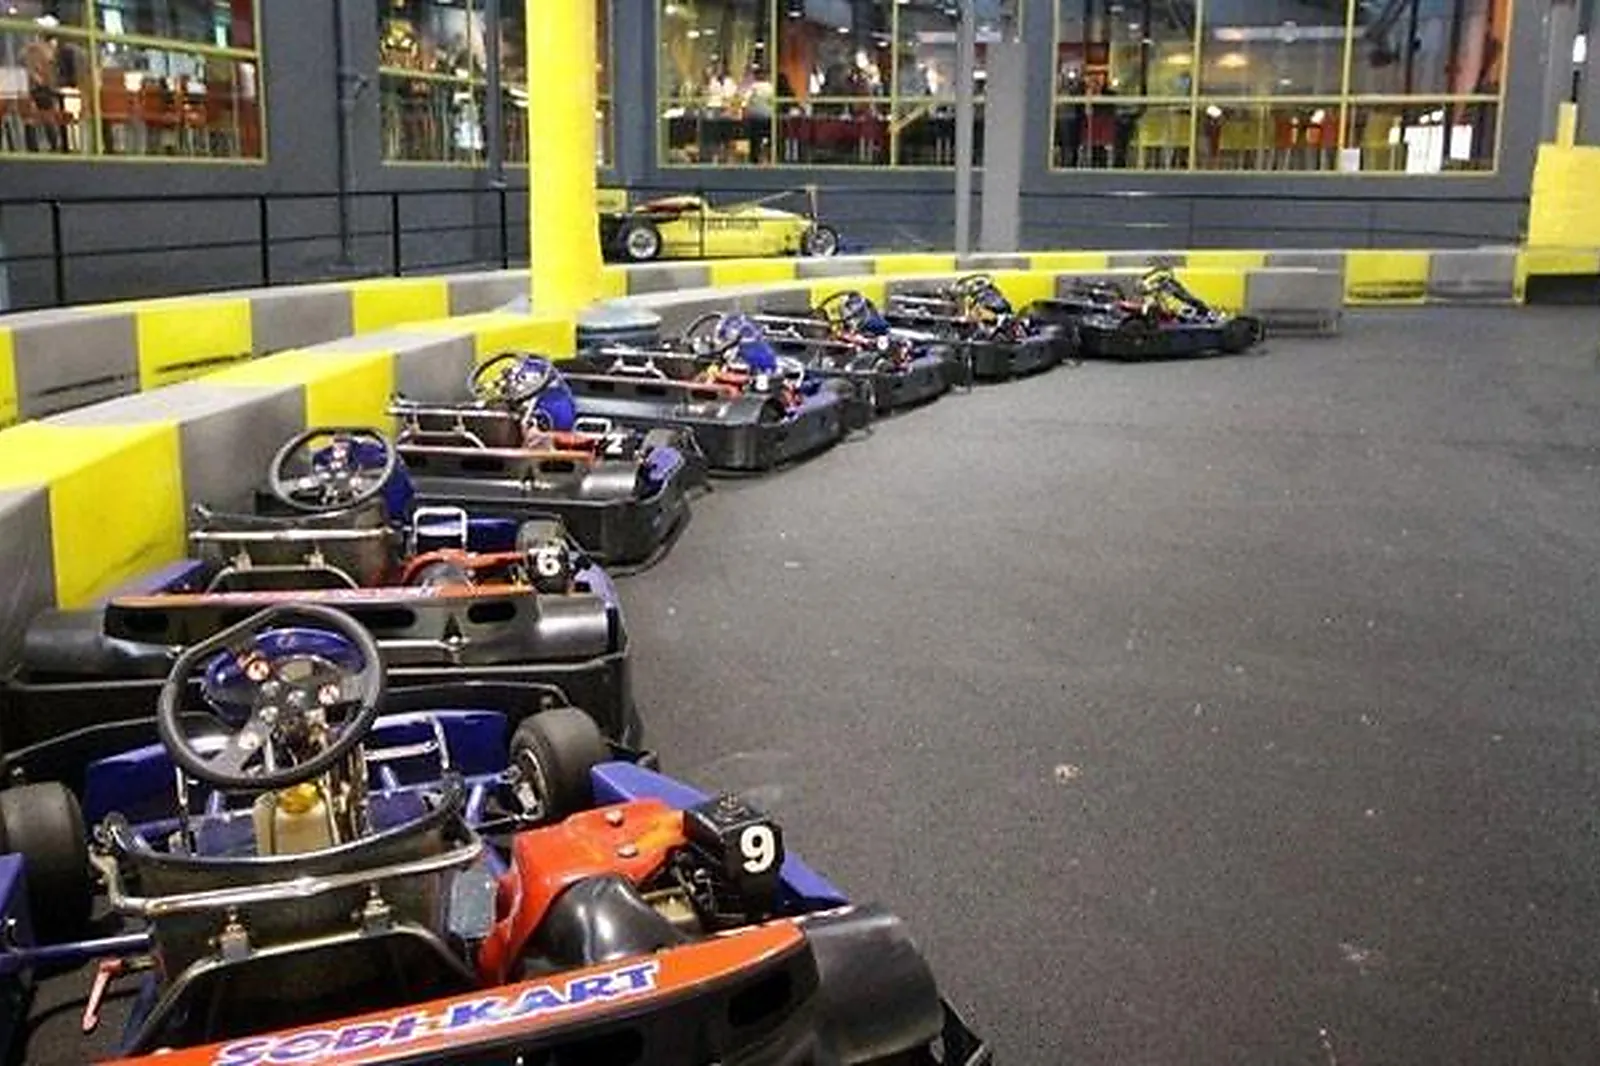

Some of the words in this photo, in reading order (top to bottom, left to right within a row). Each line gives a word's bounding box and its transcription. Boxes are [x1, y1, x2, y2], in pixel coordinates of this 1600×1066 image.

[605, 433, 624, 454] 2
[537, 549, 561, 576] 6
[740, 825, 776, 873] 9
